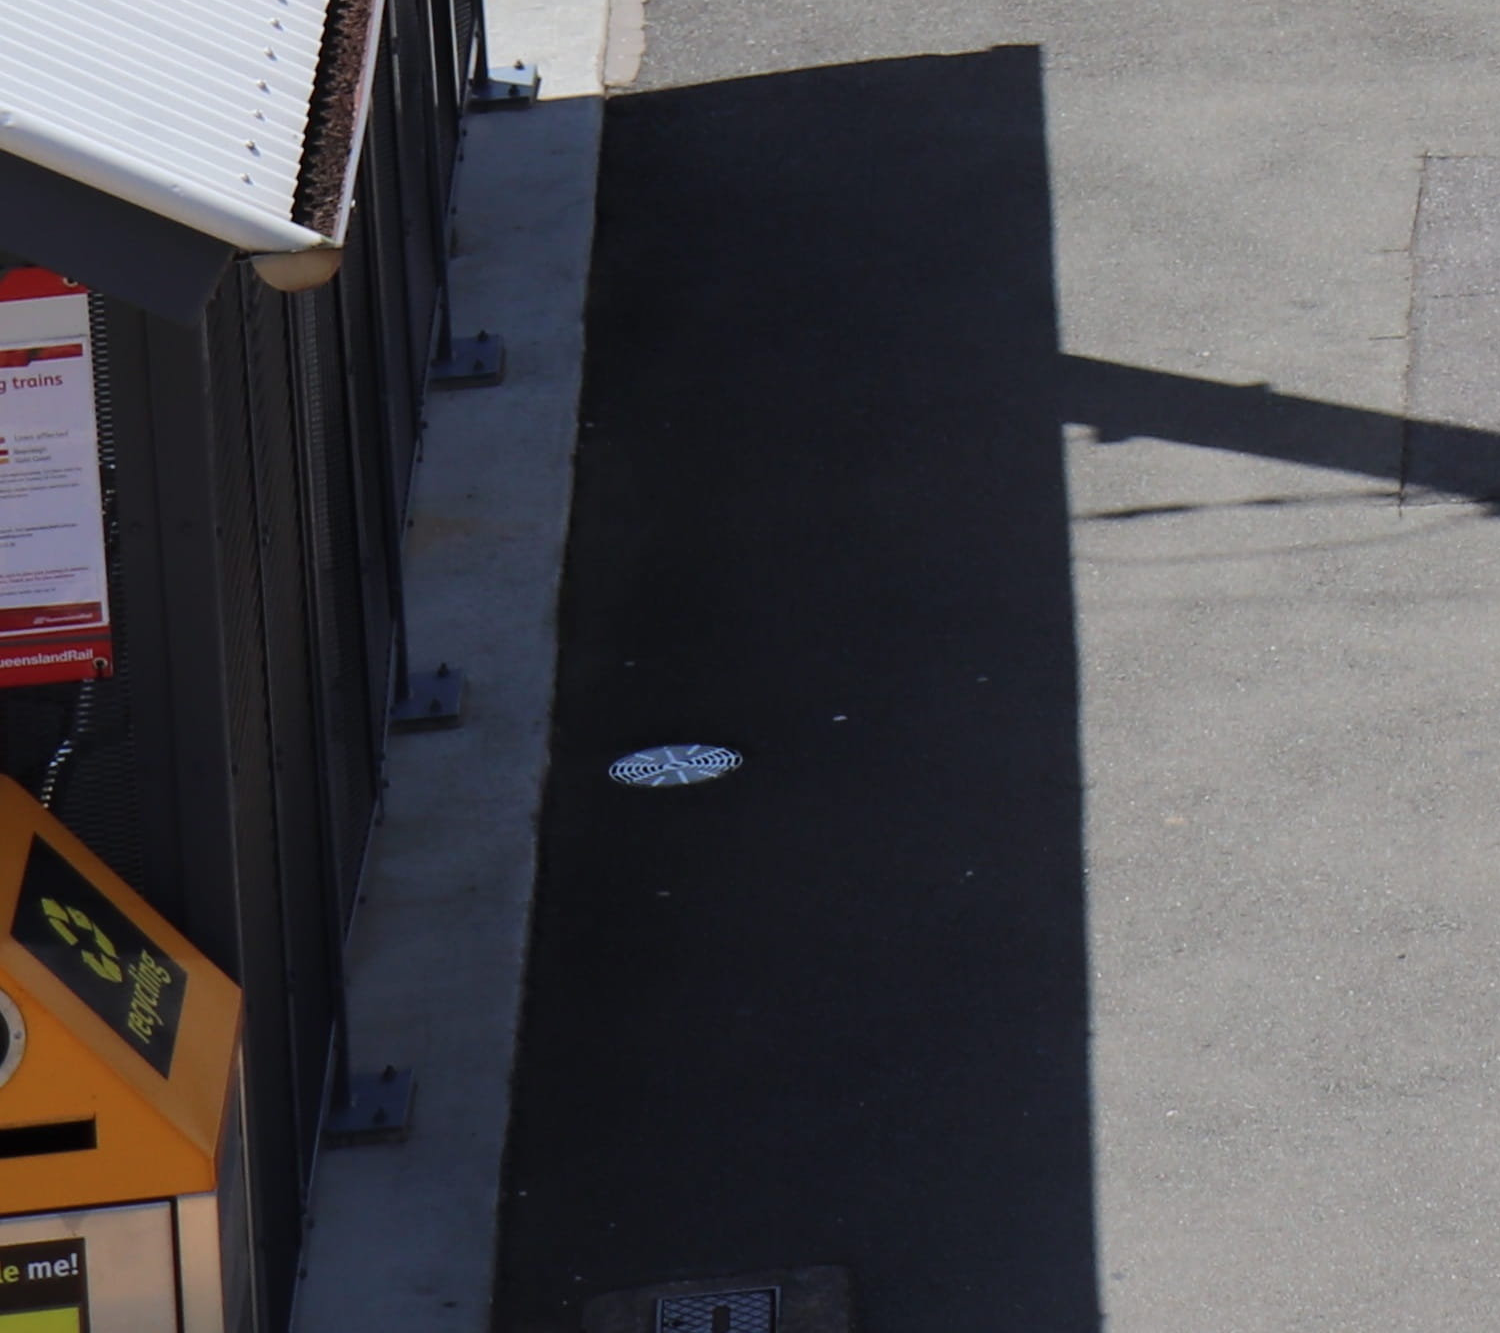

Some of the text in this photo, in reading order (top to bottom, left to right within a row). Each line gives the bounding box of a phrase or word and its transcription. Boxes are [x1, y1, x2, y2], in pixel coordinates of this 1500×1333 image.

[12, 373, 64, 389] trains
[125, 949, 172, 1045] recycling
[0, 1252, 79, 1285] e me!
